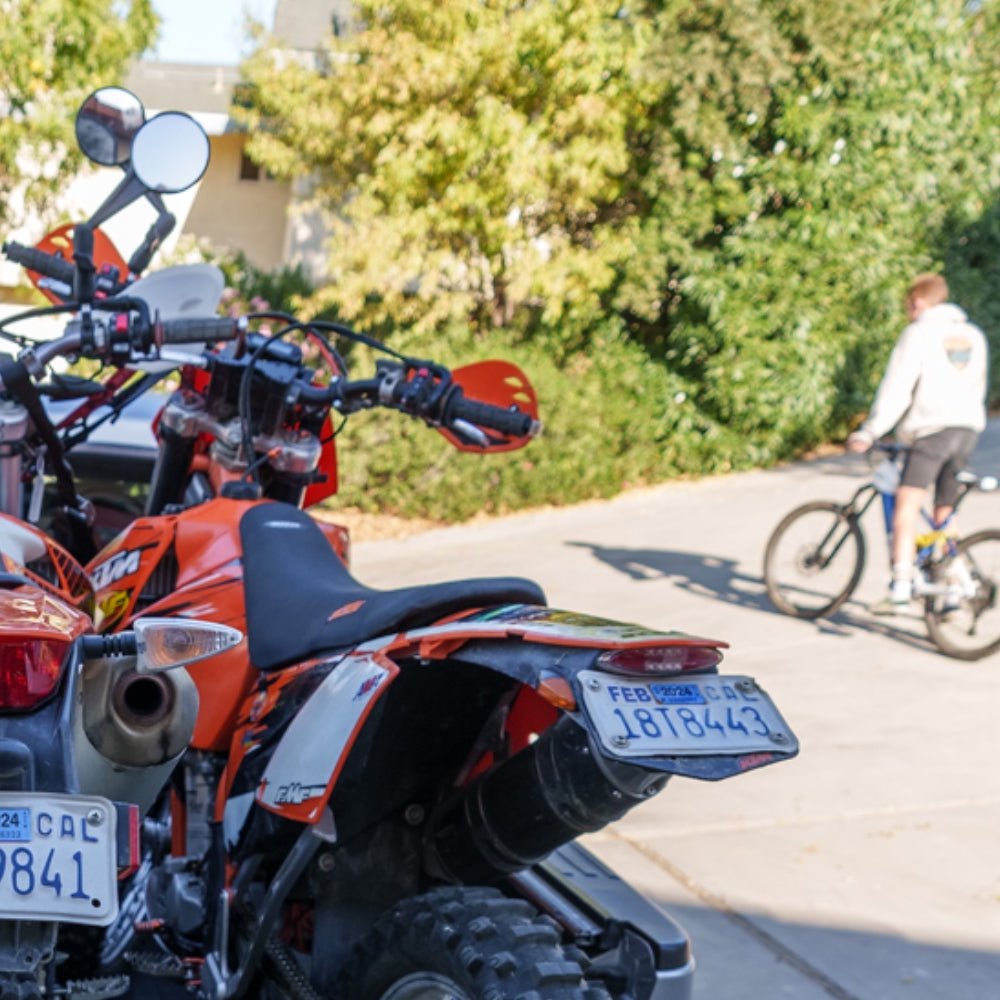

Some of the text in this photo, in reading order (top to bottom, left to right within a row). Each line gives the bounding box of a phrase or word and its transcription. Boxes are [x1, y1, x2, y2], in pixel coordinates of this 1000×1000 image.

[607, 686, 651, 702] FEB
[660, 686, 693, 696] 2024
[613, 706, 771, 740] 18T8443
[36, 812, 99, 843] CAL
